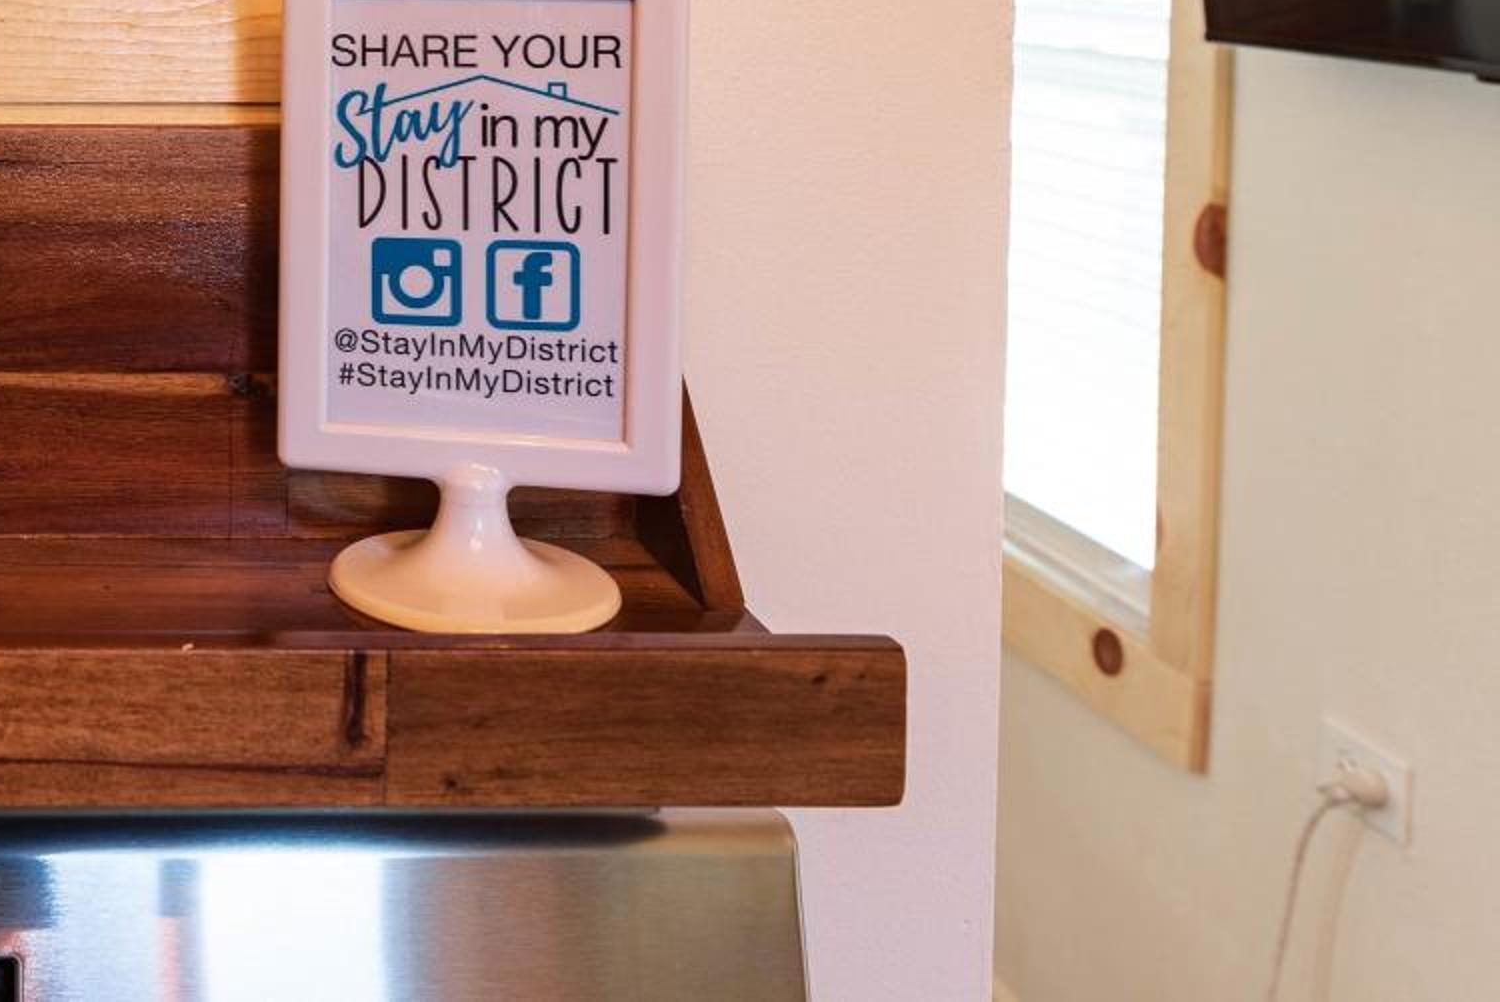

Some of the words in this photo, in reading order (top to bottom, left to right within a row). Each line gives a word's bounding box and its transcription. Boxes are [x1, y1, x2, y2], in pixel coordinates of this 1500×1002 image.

[331, 34, 477, 67] SHARE
[493, 35, 621, 69] YOUR
[335, 84, 473, 168] Stay
[481, 104, 517, 148] in
[535, 116, 608, 160] my
[358, 155, 618, 234] DISTRICT
[335, 328, 619, 364] @StayInMyDistrict
[339, 364, 615, 398] #StayInMyDistrict
